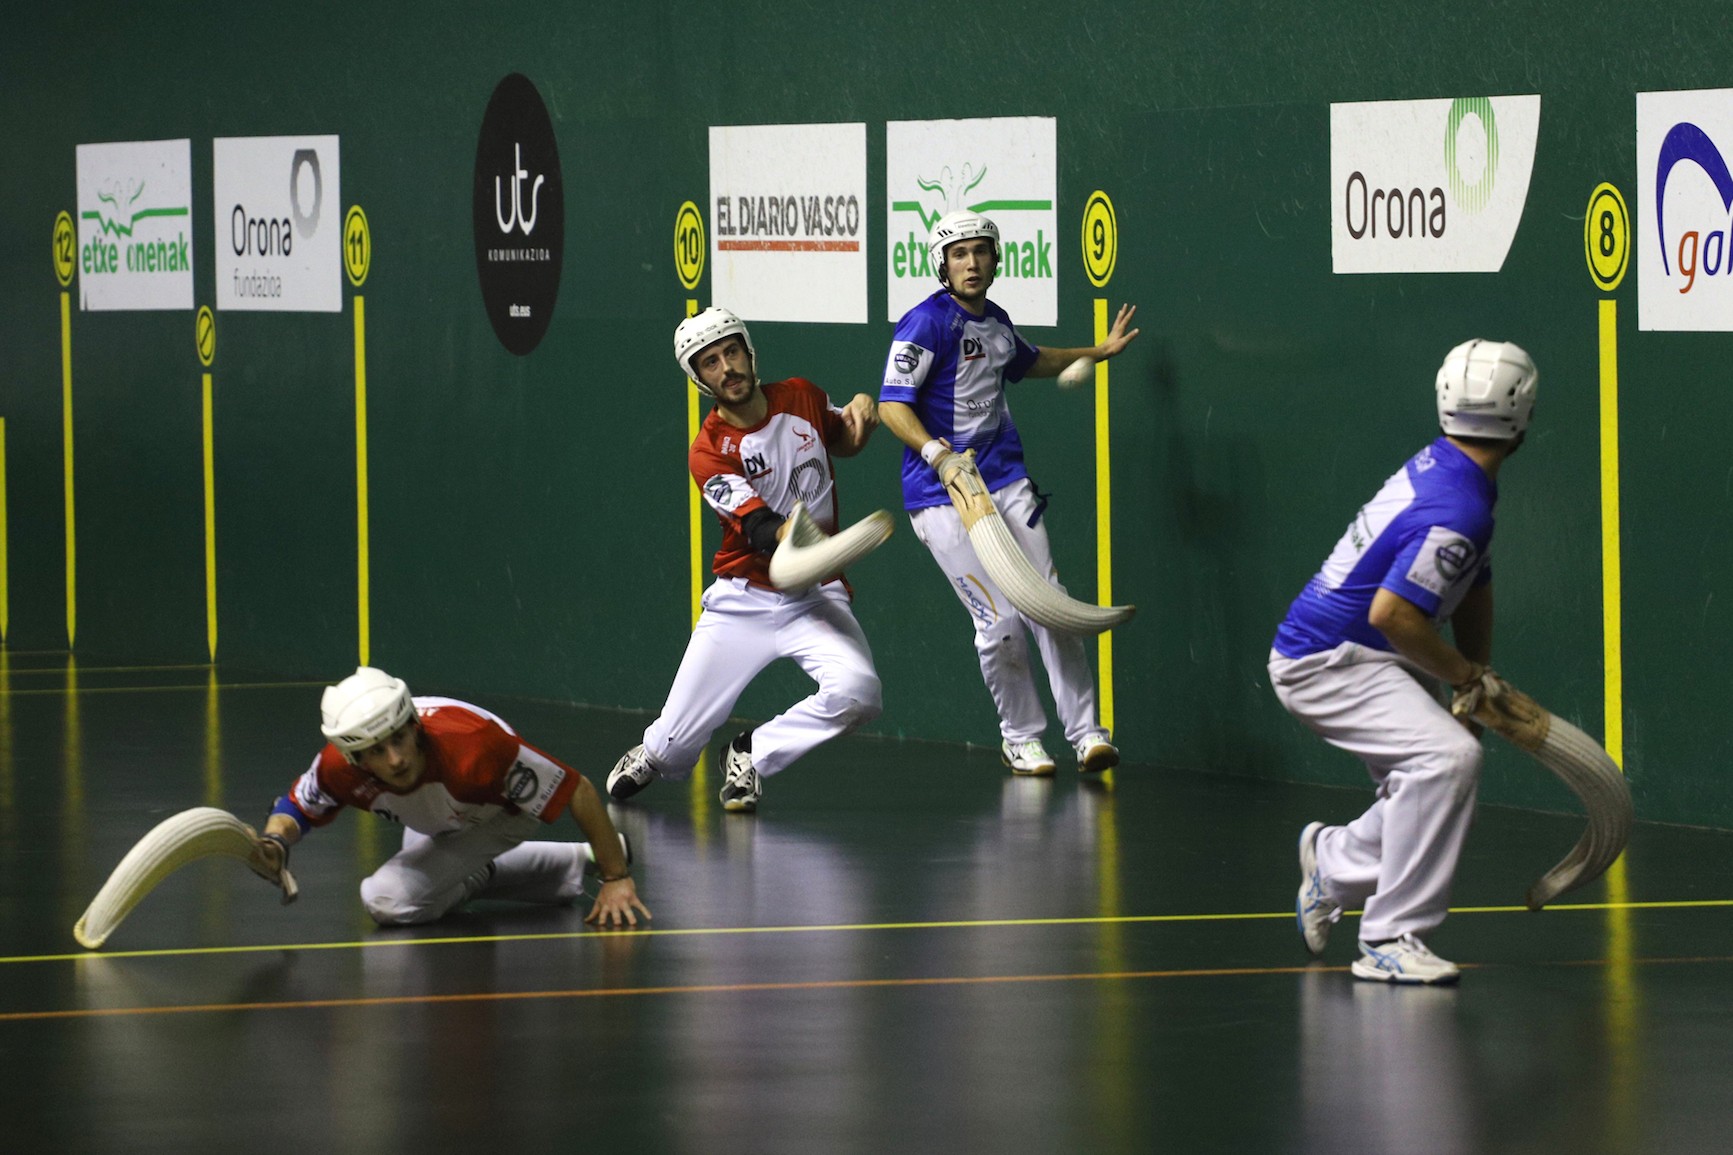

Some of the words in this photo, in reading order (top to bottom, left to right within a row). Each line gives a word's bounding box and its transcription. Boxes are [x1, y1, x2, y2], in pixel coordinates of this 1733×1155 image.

[496, 142, 545, 236] uts
[1345, 171, 1446, 240] Orona
[231, 204, 293, 258] Orona
[718, 197, 737, 236] EL
[739, 195, 798, 236] DIARIO
[800, 194, 859, 236] VASCO
[1599, 210, 1615, 258] 8
[56, 231, 72, 264] 12
[83, 234, 118, 274] etxe
[126, 231, 190, 273] onenak
[348, 230, 365, 266] 11
[488, 249, 551, 262] KOMUNIKAZIOA
[679, 227, 699, 265] 10
[1093, 219, 1106, 261] 9
[233, 268, 282, 298] fundazioa
[963, 338, 983, 356] DV
[744, 453, 766, 476] DV
[541, 770, 564, 801] Suecia
